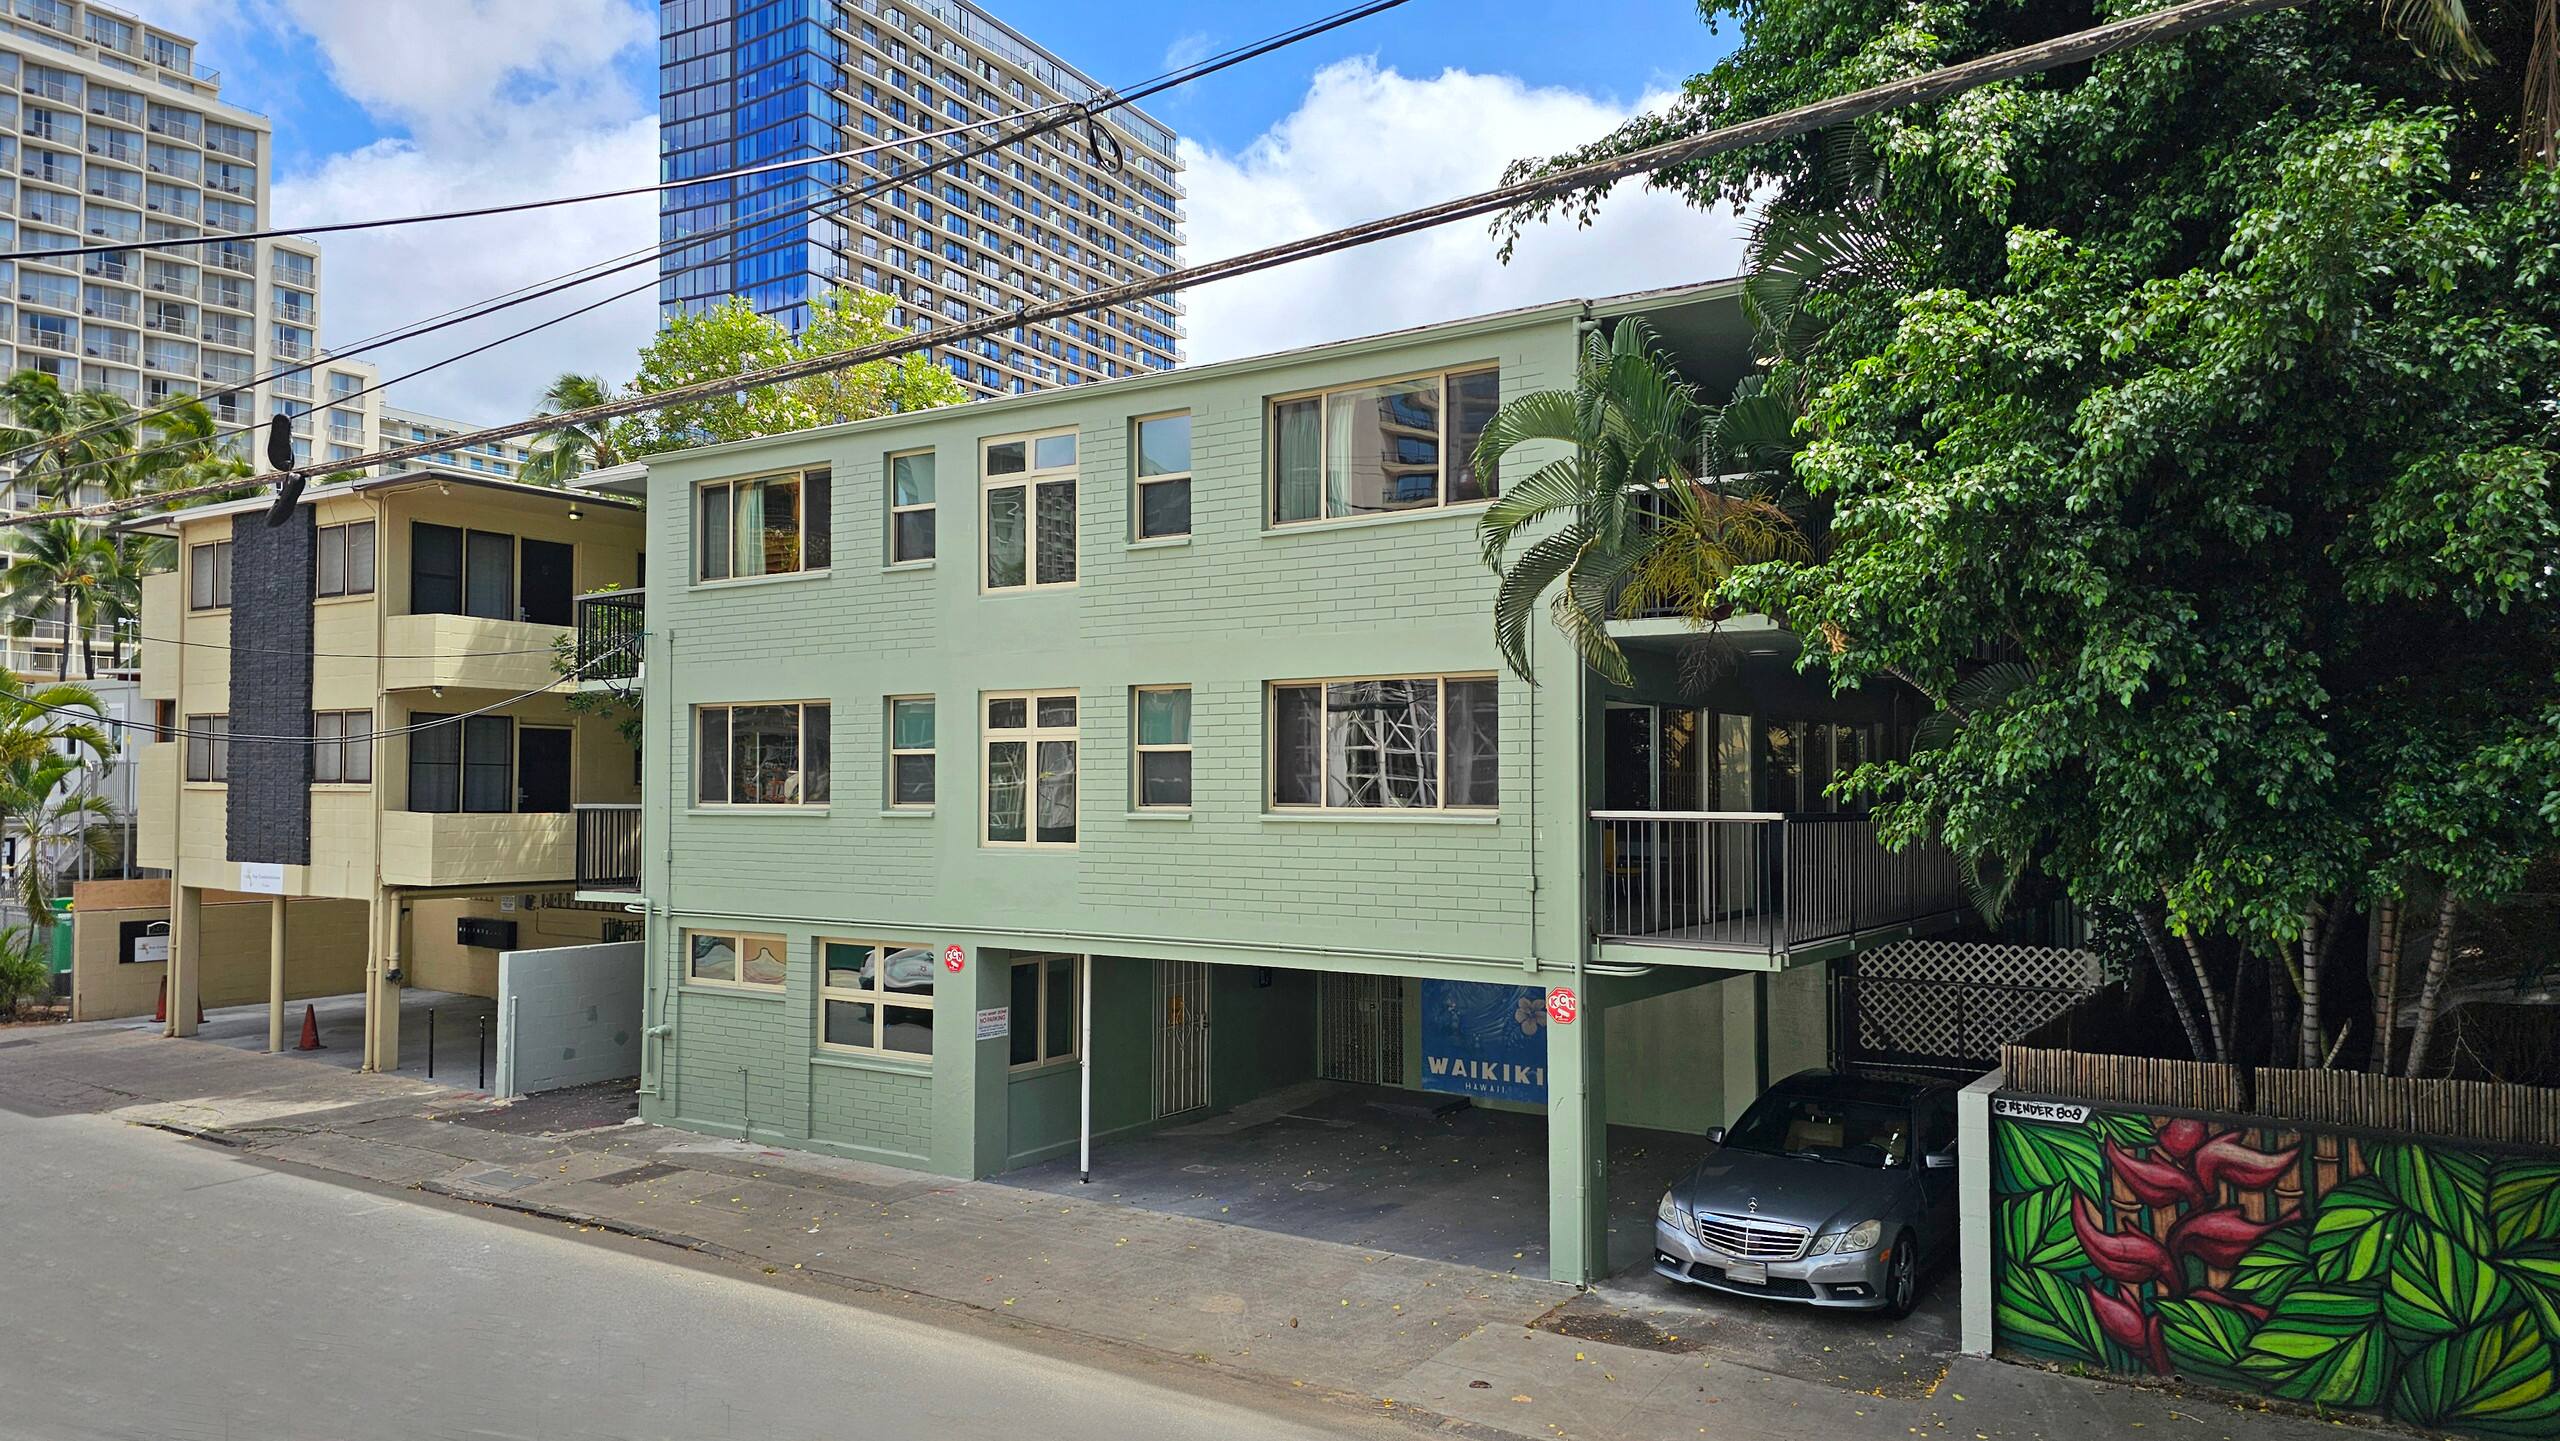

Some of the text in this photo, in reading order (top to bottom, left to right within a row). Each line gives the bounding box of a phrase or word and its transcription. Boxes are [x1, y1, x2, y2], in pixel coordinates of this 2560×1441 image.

[946, 950, 963, 961] KCN
[1550, 995, 1576, 1009] KCN
[1427, 1056, 1544, 1086] WAIKIKI
[1464, 1082, 1505, 1093] HAWAII
[2056, 1107, 2082, 1120] 808
